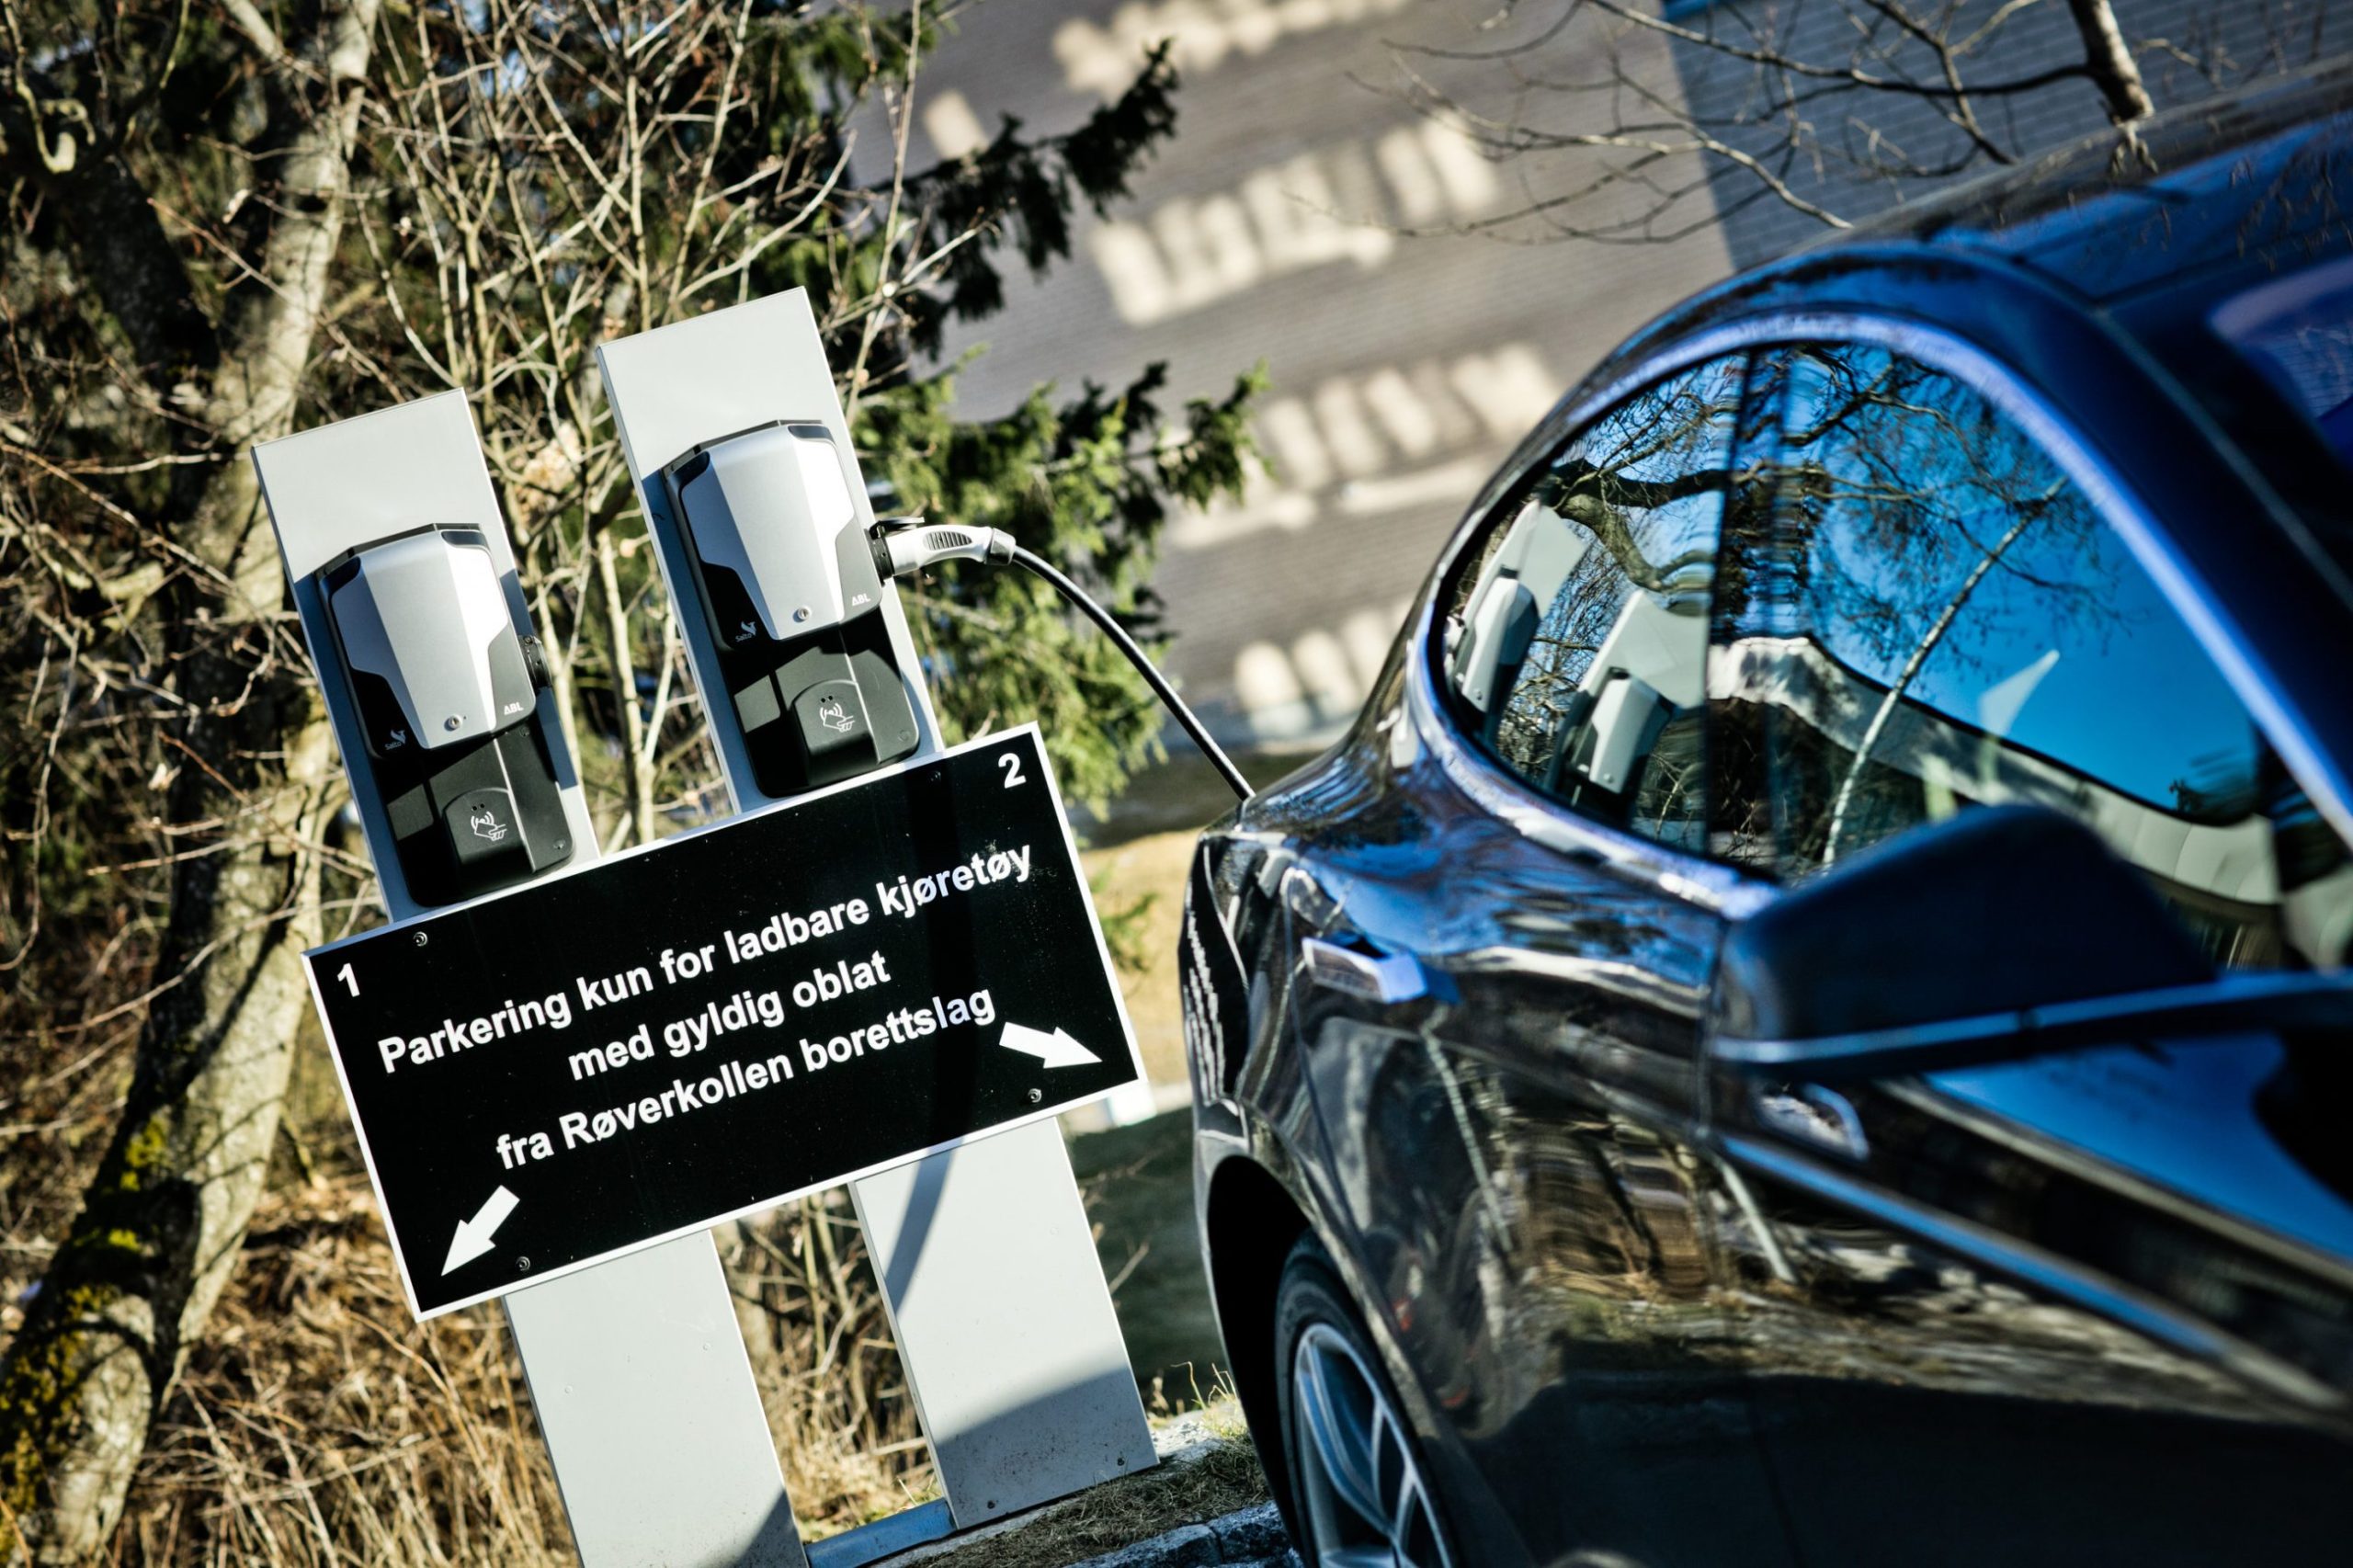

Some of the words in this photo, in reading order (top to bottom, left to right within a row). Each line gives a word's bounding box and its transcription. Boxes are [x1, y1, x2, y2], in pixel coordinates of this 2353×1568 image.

[852, 593, 871, 607] ABL
[504, 701, 524, 716] ABL
[997, 752, 1027, 790] 2
[377, 992, 573, 1074] Parkering
[575, 966, 654, 1011] kun
[659, 944, 715, 984] for
[723, 898, 870, 964] ladbare
[875, 844, 1031, 919] kjøretøy
[336, 962, 360, 997] 1
[568, 1023, 655, 1081] med
[664, 990, 785, 1058] gyldig
[792, 949, 892, 1008] oblat
[495, 1131, 555, 1170] fra
[558, 1054, 794, 1150] Røverkollen
[799, 988, 996, 1073] borettslag
